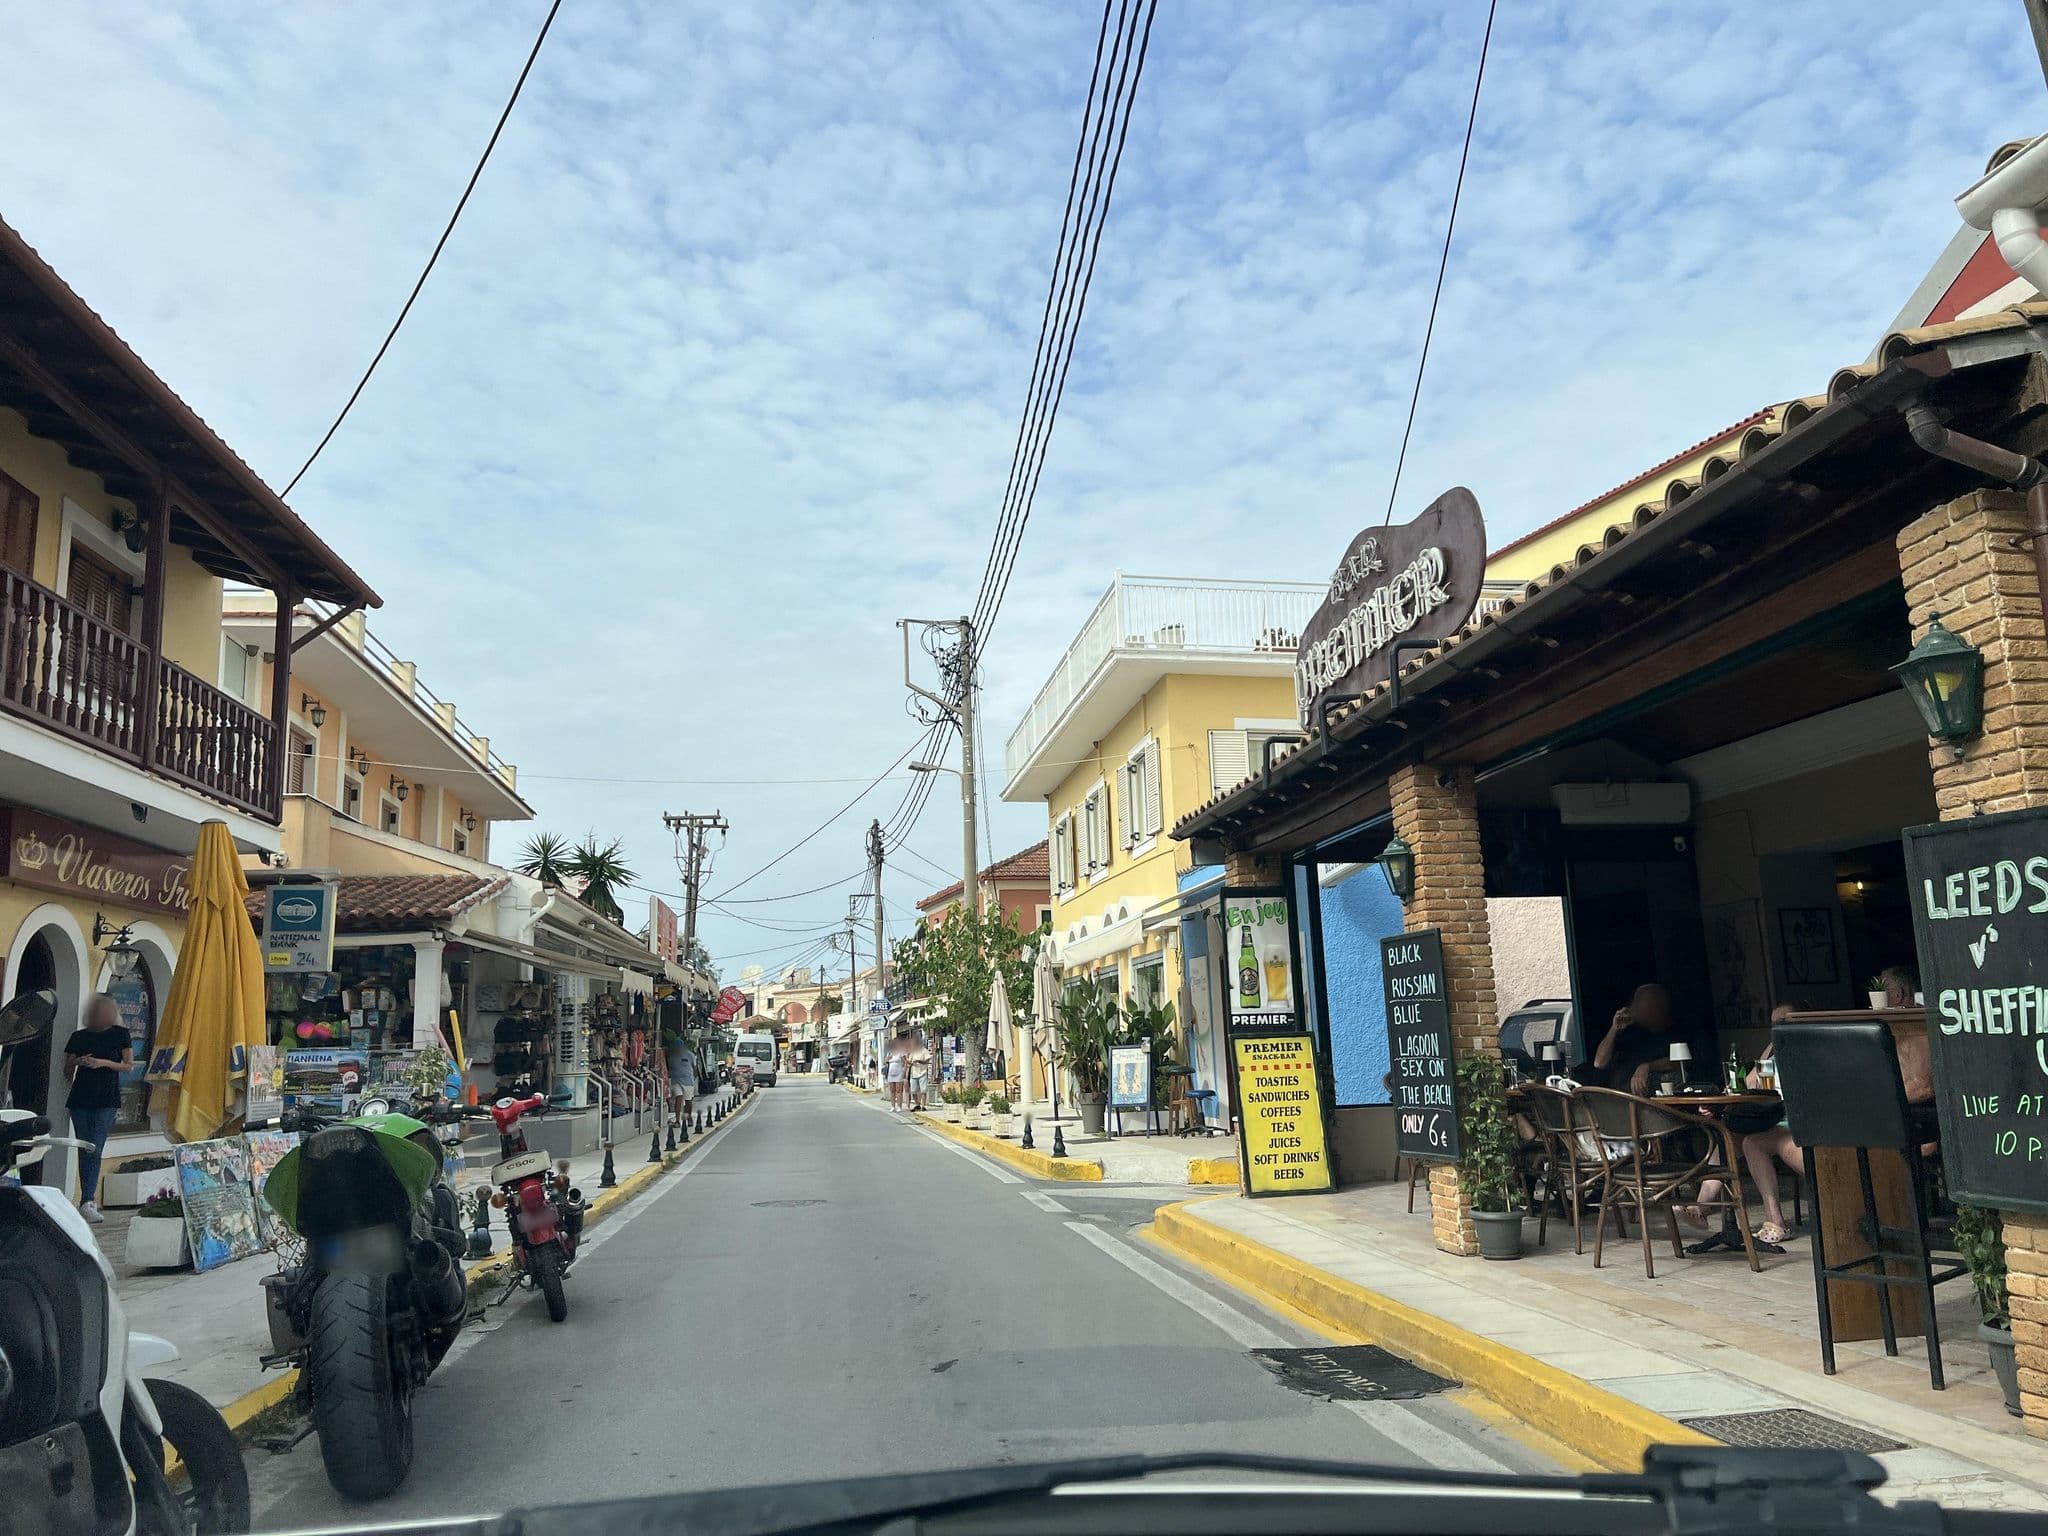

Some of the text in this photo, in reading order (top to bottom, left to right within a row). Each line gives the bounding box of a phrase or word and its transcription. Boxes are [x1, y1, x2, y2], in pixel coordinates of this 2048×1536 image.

[53, 834, 151, 900] Vlaseros
[1924, 857, 2048, 919] LEEDS
[1227, 899, 1288, 927] Enjoy
[270, 933, 320, 941] NATIONAL
[1388, 943, 1422, 966] BLACK
[1391, 973, 1436, 998] RUSSIAN
[1393, 1003, 1422, 1025] BLUE
[1939, 986, 2048, 1036] SHEFFI
[1244, 1042, 1303, 1053] PREMIER
[1398, 1032, 1439, 1057] LAGOON
[1400, 1060, 1445, 1077] SEX ON
[1256, 1076, 1299, 1087] TOASTIES
[1248, 1090, 1310, 1103] SANDWICHES
[1400, 1084, 1452, 1106] THE BEACH
[1963, 1094, 2044, 1117] LIVE AT
[1261, 1106, 1301, 1118] COFFEES
[1271, 1122, 1295, 1132] TEAS
[1402, 1114, 1425, 1134] ONLY
[1269, 1137, 1301, 1149] JUICES
[1995, 1131, 2017, 1156] 10
[1254, 1151, 1320, 1165] SOFT DRINKS
[1274, 1168, 1304, 1180] BEERS
